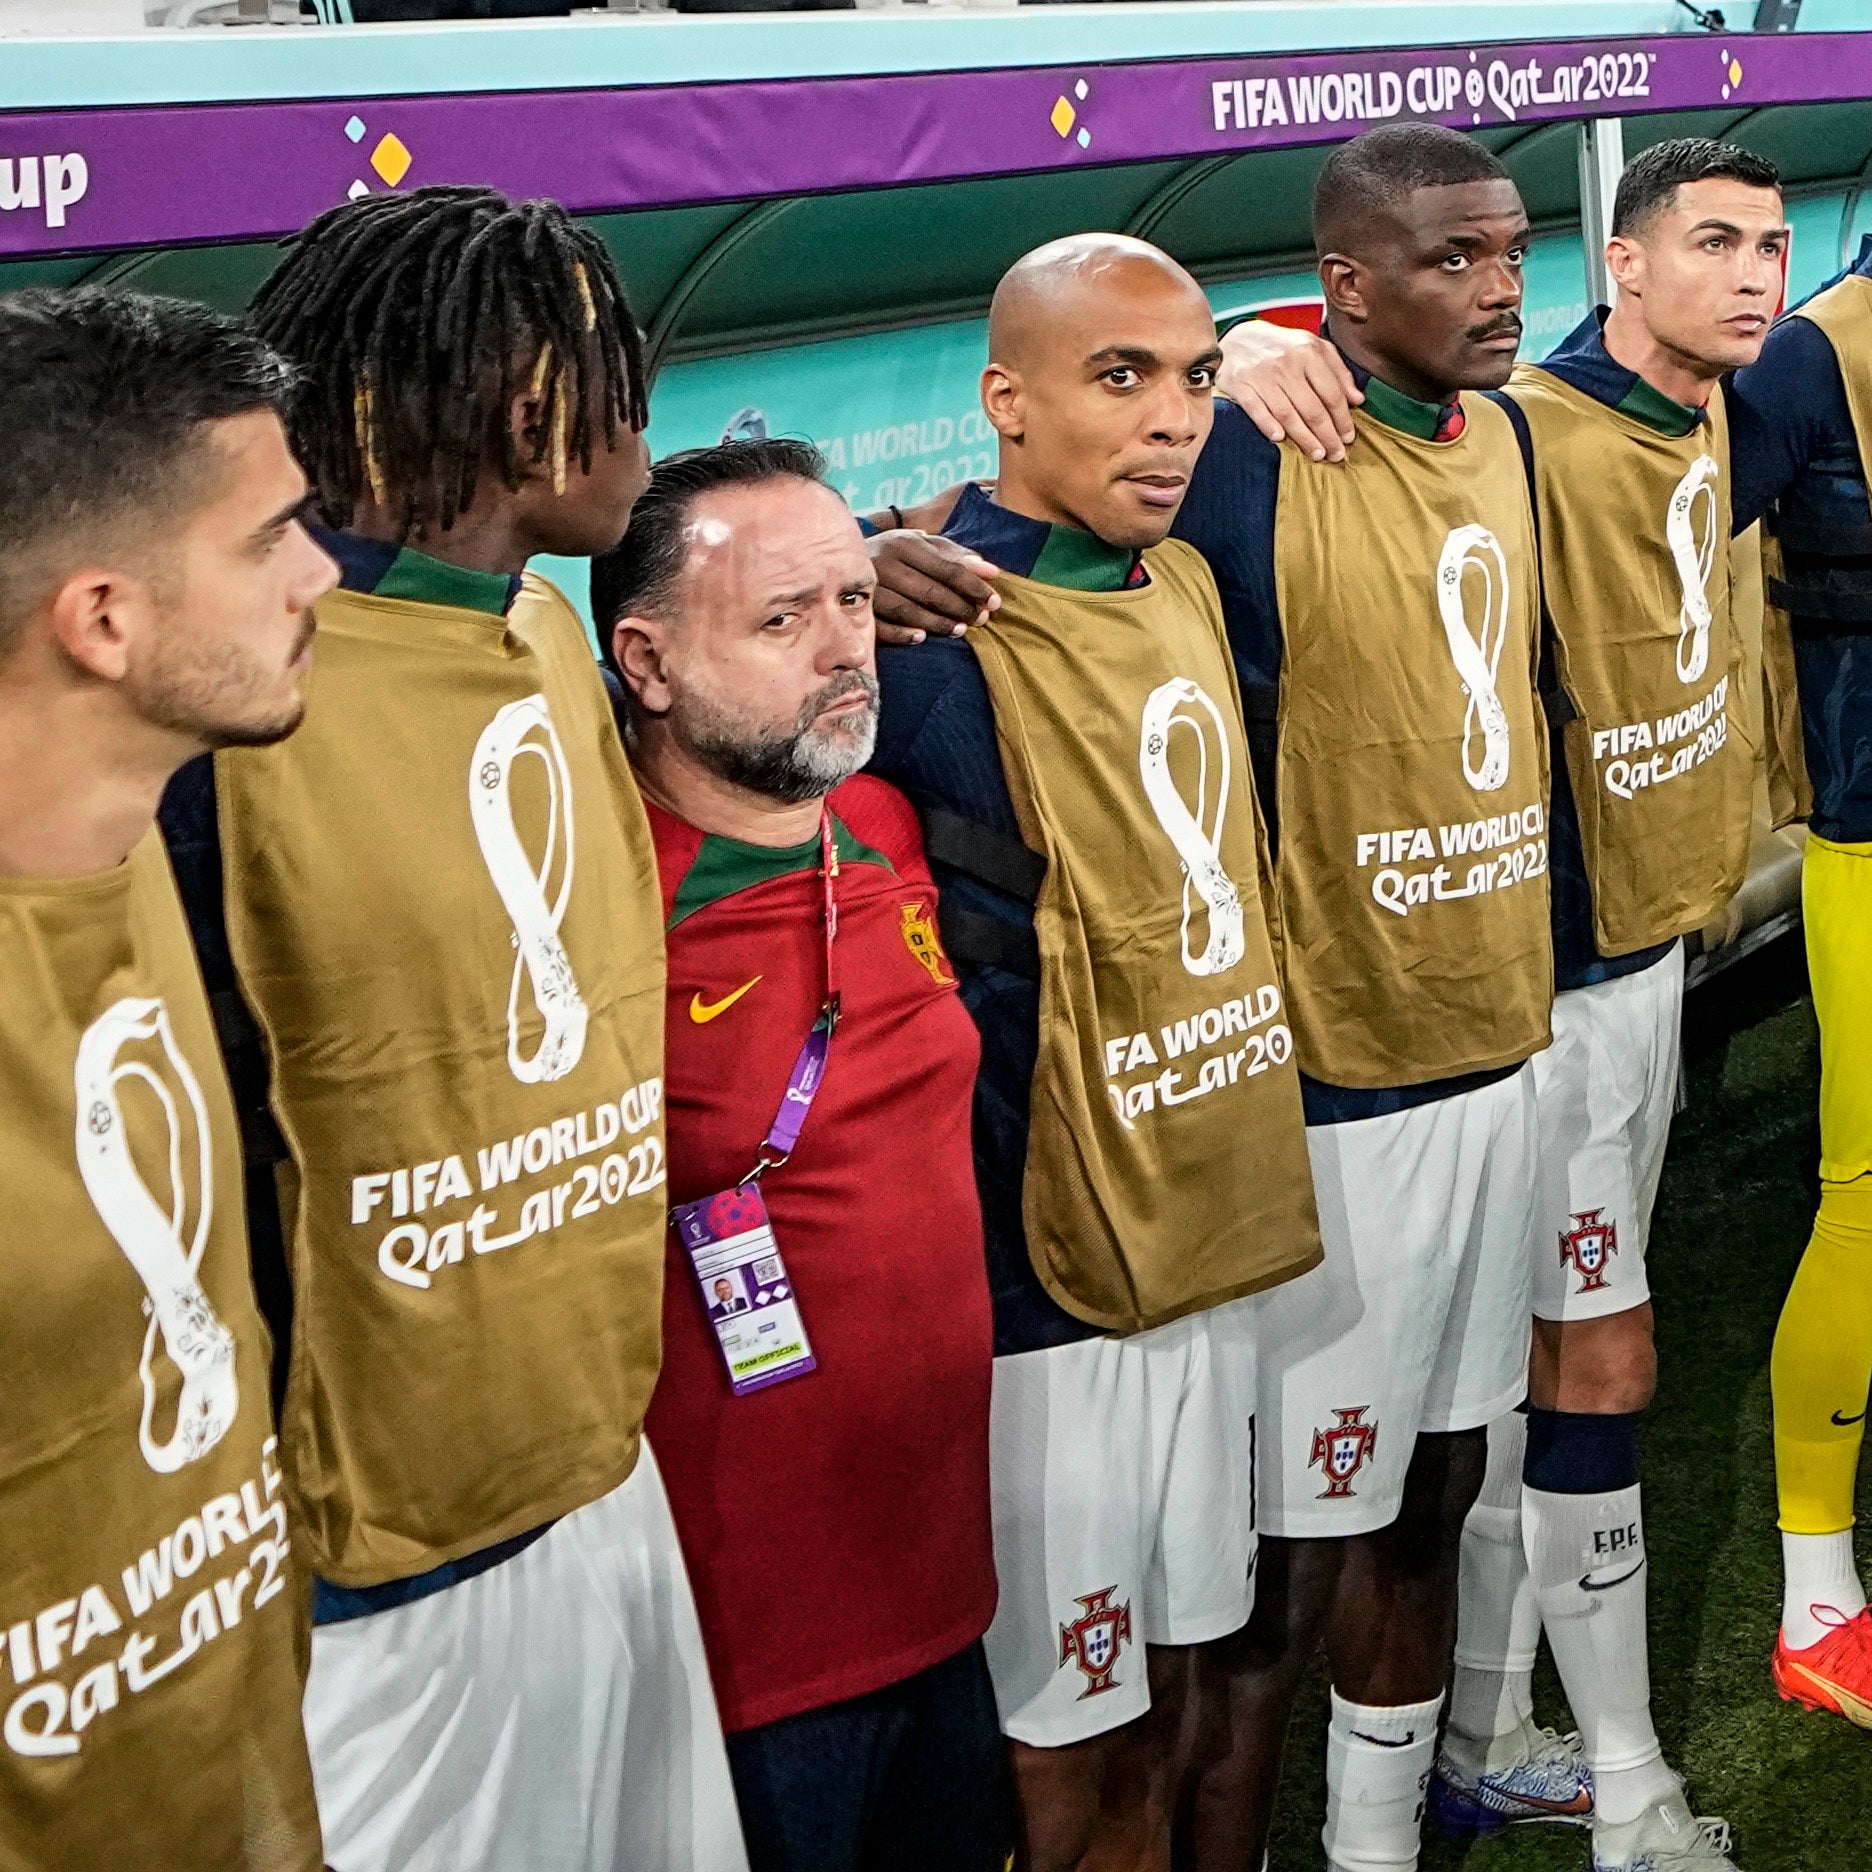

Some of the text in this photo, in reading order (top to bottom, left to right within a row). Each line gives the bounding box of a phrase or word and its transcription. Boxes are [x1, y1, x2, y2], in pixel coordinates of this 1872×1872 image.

[1211, 79, 1289, 131] FIFA
[1288, 71, 1403, 124] WORLD
[1406, 66, 1462, 114] CUP
[0, 151, 88, 227] up
[853, 416, 954, 467] WORLD
[959, 411, 998, 443] CU
[1593, 722, 1653, 760] FIFA
[1656, 693, 1713, 745] WORLD
[1357, 803, 1544, 867] FIFA WORLD CU
[1105, 985, 1280, 1078] FA WORLD
[351, 1077, 664, 1225] FIFA WORLD CUP
[0, 1435, 284, 1685] IFA WORL
